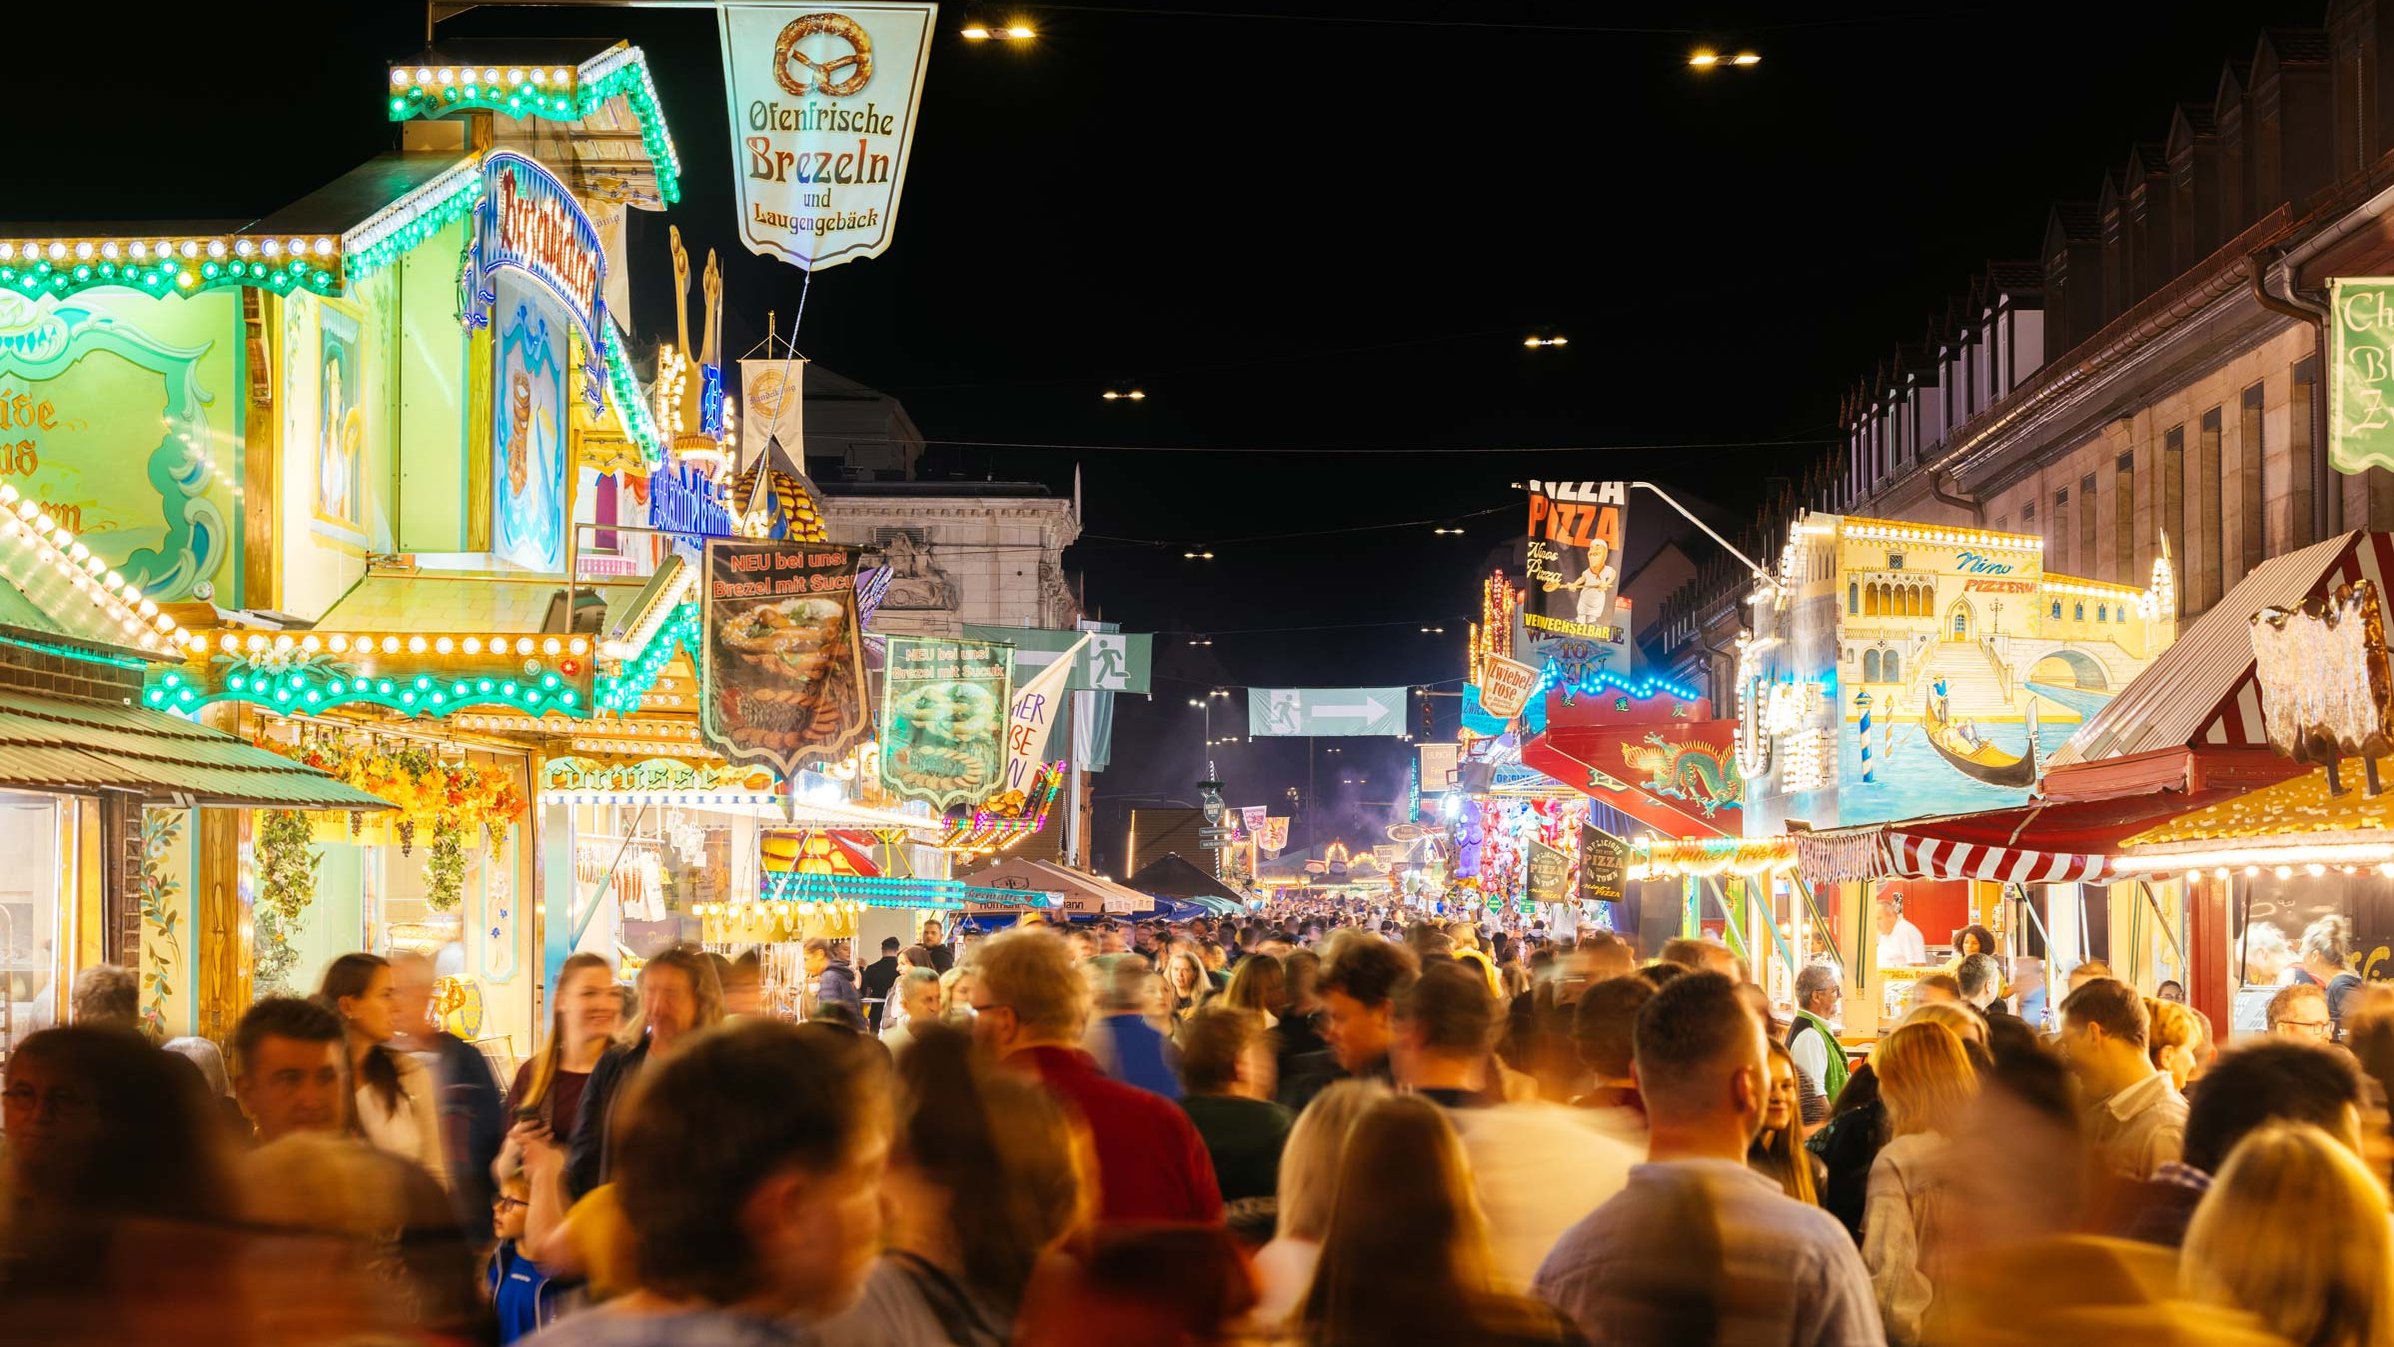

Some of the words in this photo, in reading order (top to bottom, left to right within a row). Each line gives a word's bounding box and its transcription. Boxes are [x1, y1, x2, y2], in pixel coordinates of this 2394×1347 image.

[750, 100, 894, 136] Ofenfrische
[746, 136, 889, 184] Brezeln
[803, 188, 831, 208] und
[754, 203, 878, 236] Laugengebäck
[1529, 494, 1620, 551] PIZZA
[730, 553, 770, 573] NEU
[775, 551, 803, 570] bei
[808, 551, 848, 568] uns!
[1956, 551, 2014, 575] Nino
[713, 576, 771, 598] Brezel
[775, 574, 807, 594] mit
[810, 573, 856, 592] Sucu
[1524, 613, 1611, 640] VEWECHSELBAR
[905, 648, 934, 662] NEU
[937, 648, 958, 661] bei
[961, 646, 990, 660] uns!
[892, 665, 934, 679] Brezel
[937, 664, 960, 678] mit
[962, 663, 1004, 678] Sucuk
[1492, 681, 1518, 701] rose
[1530, 864, 1563, 876] PIZZA
[1583, 854, 1624, 869] PIZZA
[1595, 889, 1621, 898] PIZZA
